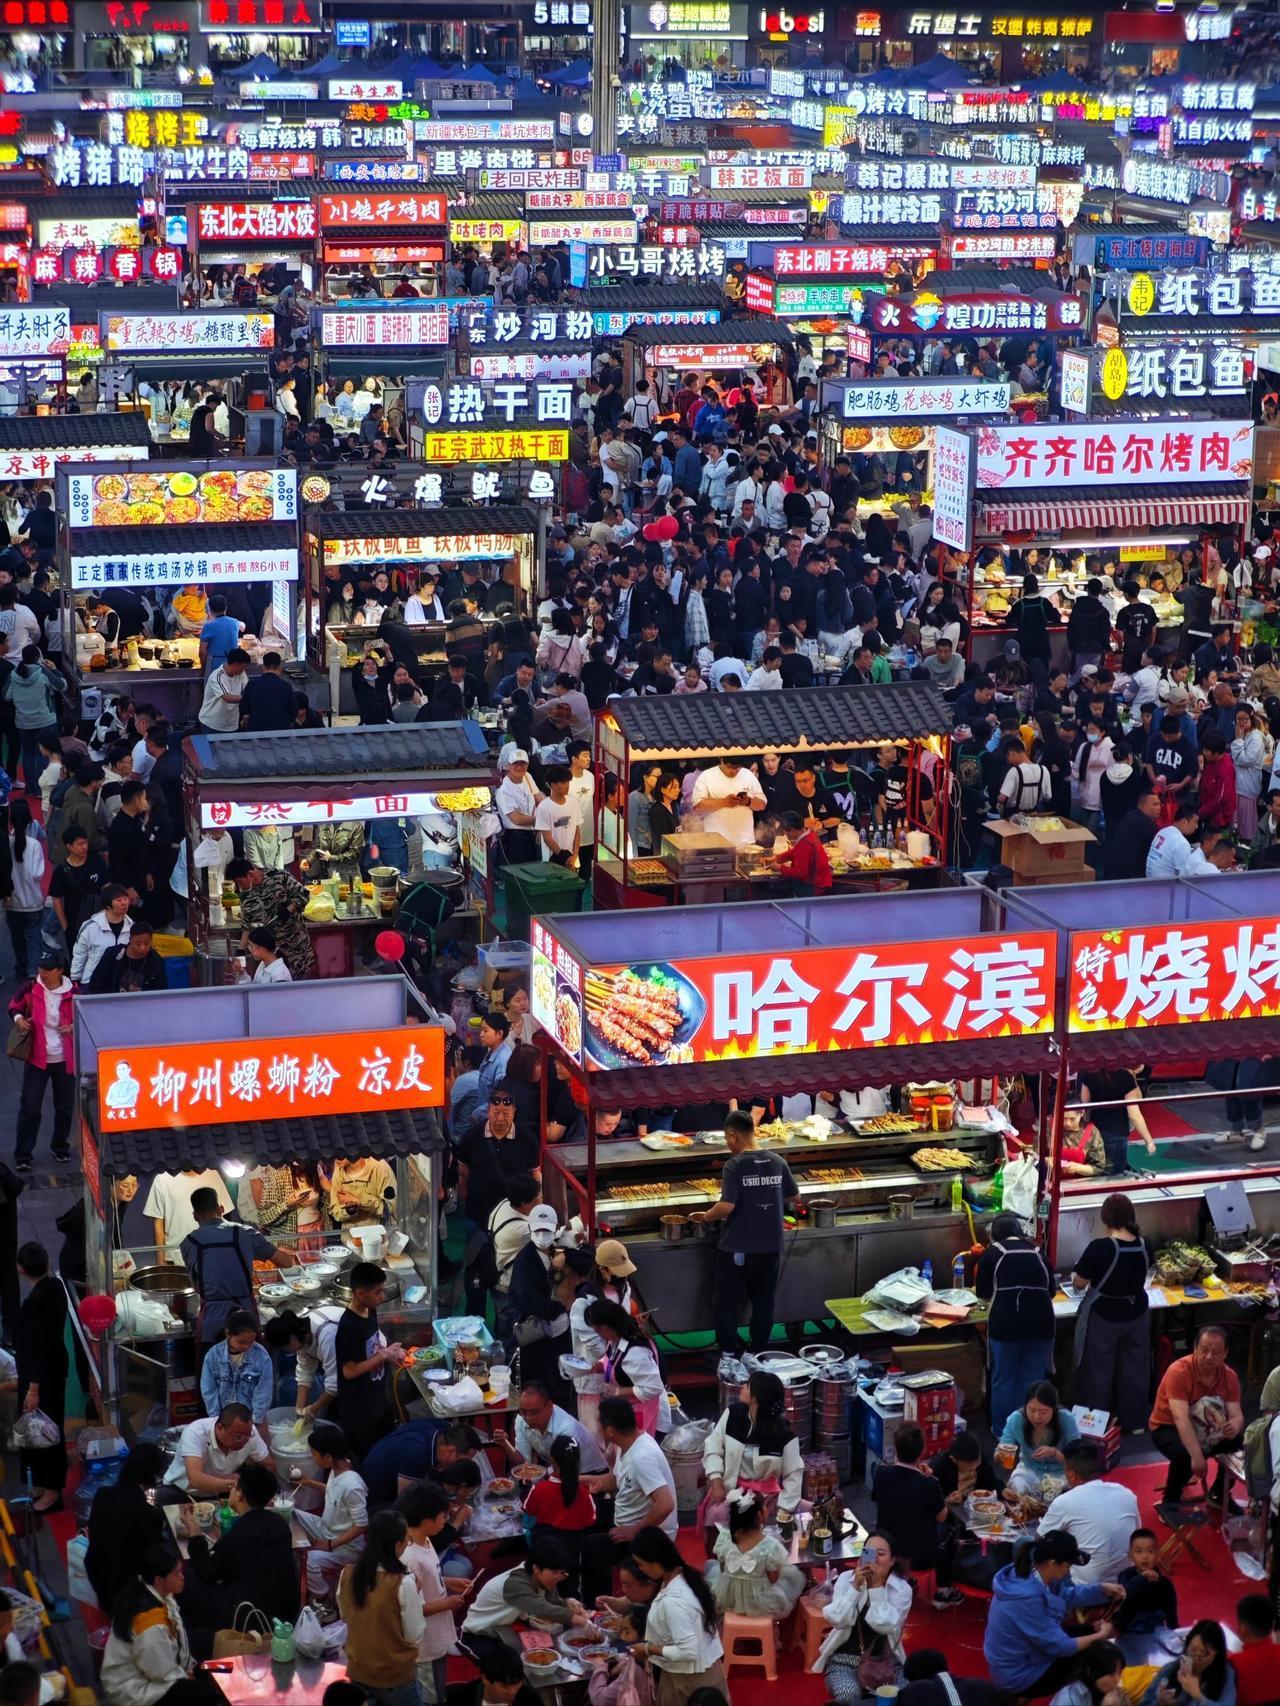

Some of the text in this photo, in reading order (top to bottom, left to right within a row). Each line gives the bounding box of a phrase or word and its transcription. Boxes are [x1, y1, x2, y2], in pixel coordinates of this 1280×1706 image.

[907, 14, 981, 35] 乐堡士
[1026, 16, 1058, 36] 炸鸡
[1182, 83, 1255, 111] 新派豆腐
[126, 111, 206, 146] 烧烤王
[237, 128, 318, 150] 海鲜烧烤
[425, 124, 491, 139] 新疆烤包子
[53, 145, 145, 187] 烤猪蹄
[340, 164, 402, 181] 西安锅贴
[490, 170, 581, 189] 老回民炸串
[717, 167, 806, 188] 韩记板面
[857, 163, 951, 190] 韩记爆肚
[954, 168, 1033, 187] 芝士烤榴莲
[529, 193, 574, 208] 糖醋丸子
[663, 202, 723, 221] 香脆锅贴
[842, 194, 941, 225] 爆汁烤冷面
[53, 223, 89, 239] 东北
[200, 205, 317, 238] 东北大馅水饺
[449, 222, 504, 239] 咕咾肉
[590, 244, 727, 278] 小马哥烧烤
[776, 249, 888, 273] 东北刚子烧烤
[1109, 239, 1197, 259] 东北烧烤海鲜
[35, 252, 178, 280] 麻辣香锅
[1159, 273, 1280, 316] 纸包鱼
[468, 310, 593, 344] 广东 炒河粉
[1060, 301, 1081, 325] 锅
[202, 316, 267, 346] 糖醋里脊
[335, 314, 377, 344] 重庆小面
[381, 314, 413, 344] 酸辣粉
[418, 314, 449, 344] 担担面
[1127, 349, 1248, 399] 纸包鱼
[427, 390, 440, 418] 张记
[448, 383, 574, 422] 热干面
[431, 433, 565, 461] 正宗武汉热干面
[1004, 431, 1232, 479] 齐齐哈尔烤肉
[360, 469, 555, 503] 火爆鱿鱼
[1156, 748, 1183, 770] GAP
[712, 941, 1048, 1052] 哈尔滨
[1075, 944, 1110, 1022] 特色
[149, 1044, 434, 1113] 柳州螺蛳粉 凉皮
